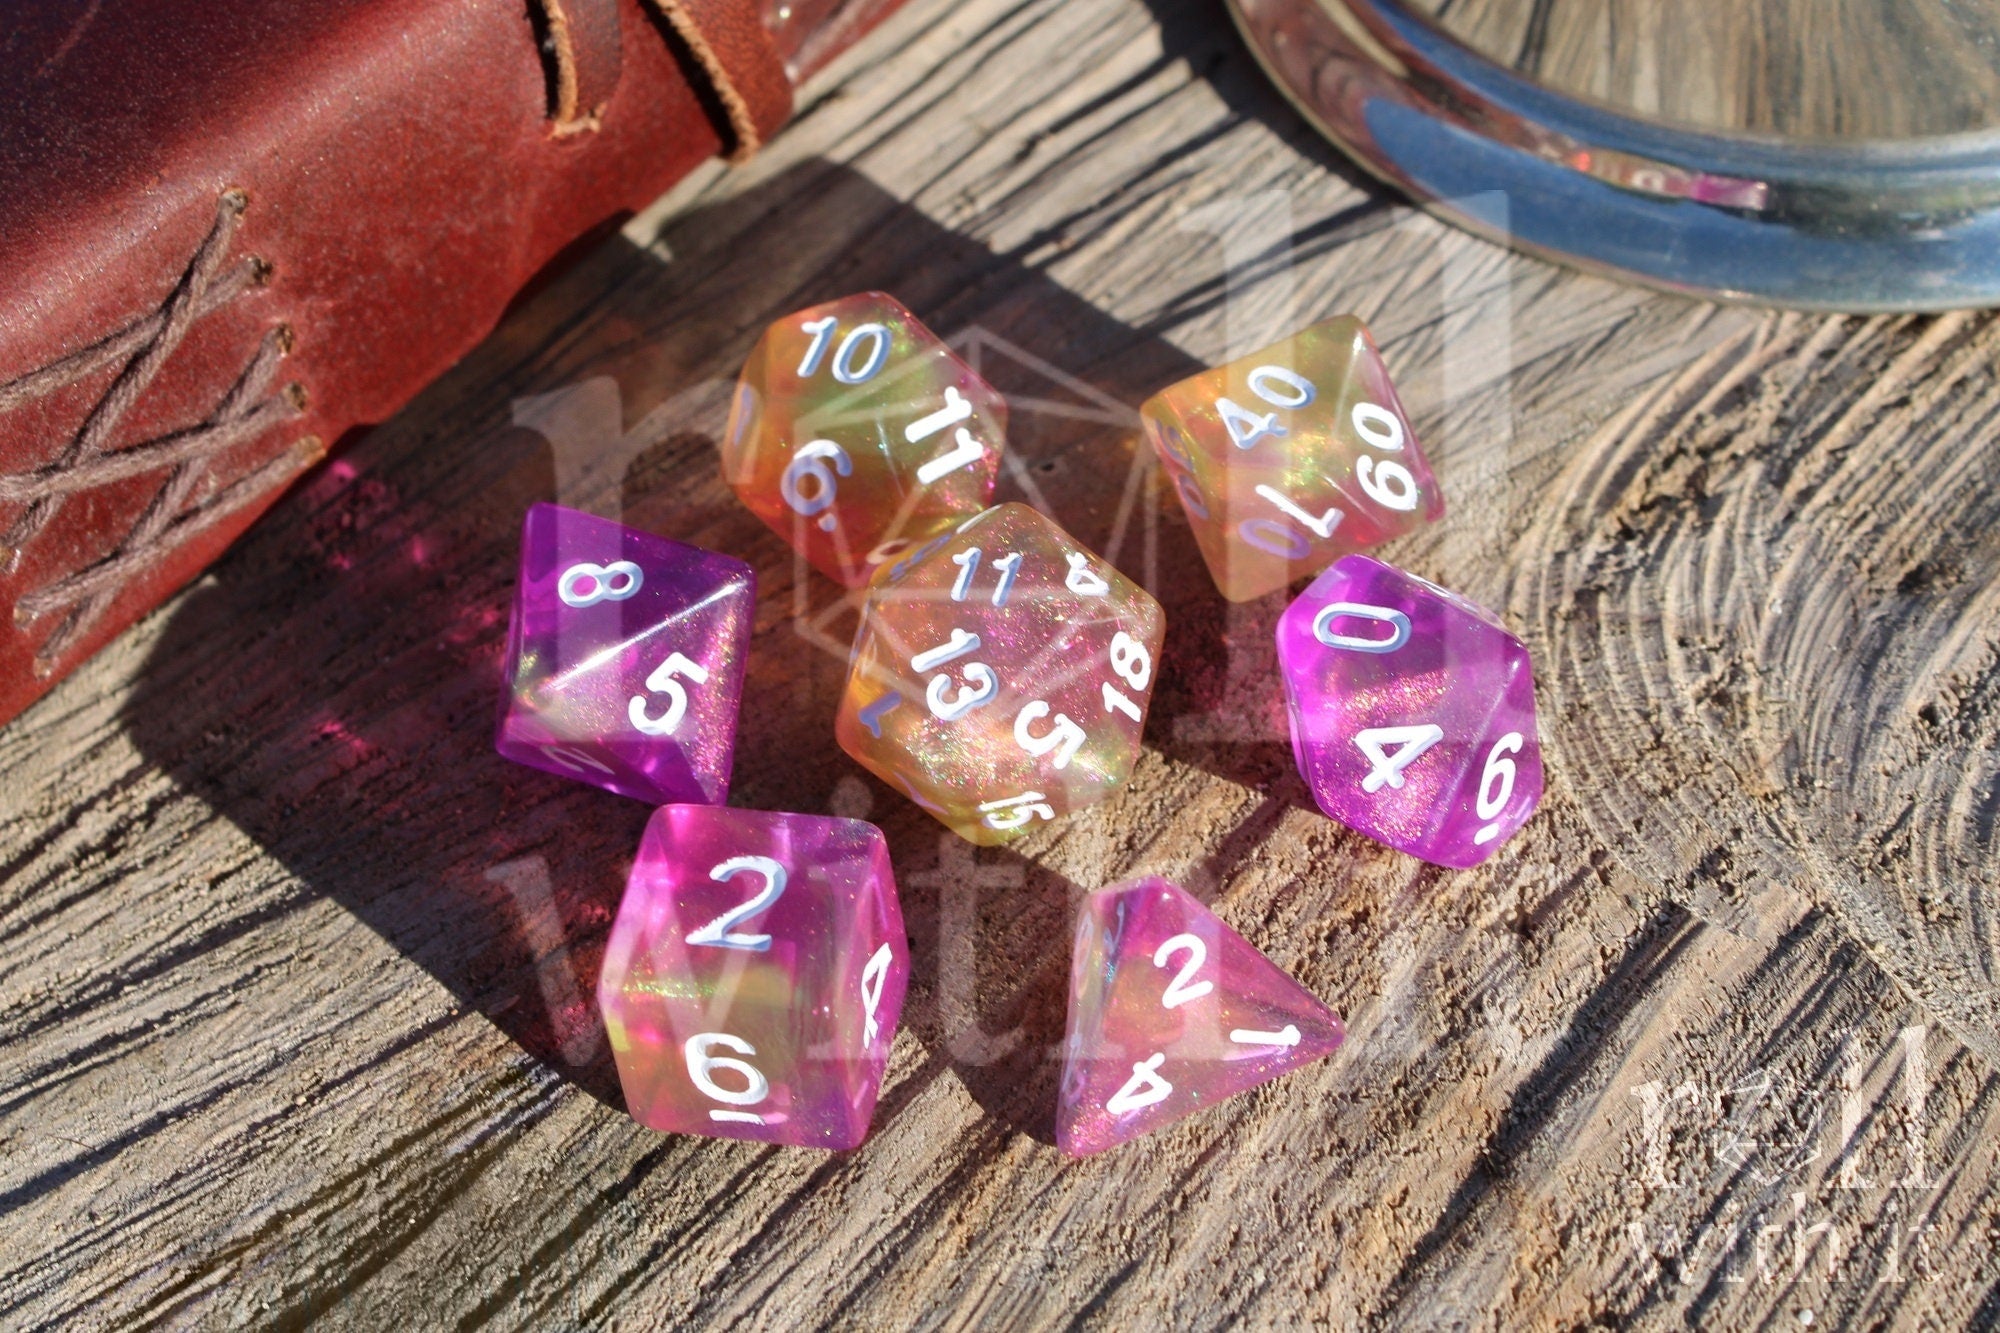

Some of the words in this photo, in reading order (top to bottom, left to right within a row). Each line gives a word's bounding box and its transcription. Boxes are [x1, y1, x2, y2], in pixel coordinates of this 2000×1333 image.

[797, 316, 891, 384] 10
[905, 386, 984, 484] 11
[1215, 365, 1316, 450] 40
[1351, 402, 1417, 511] 60
[558, 561, 644, 608] 8
[950, 547, 1023, 606] 11
[1065, 552, 1109, 596] 4
[1312, 602, 1412, 653] 0
[628, 652, 709, 735] 5
[910, 628, 999, 721] 13
[1102, 631, 1151, 722] 18
[1013, 700, 1087, 770] 5
[1352, 724, 1444, 793] 4
[976, 791, 1056, 829] 15
[685, 855, 787, 952] 2
[861, 942, 892, 1049] 4
[1153, 933, 1214, 1009] 2
[1229, 1024, 1301, 1047] 1
[1106, 1052, 1173, 1115] 4
